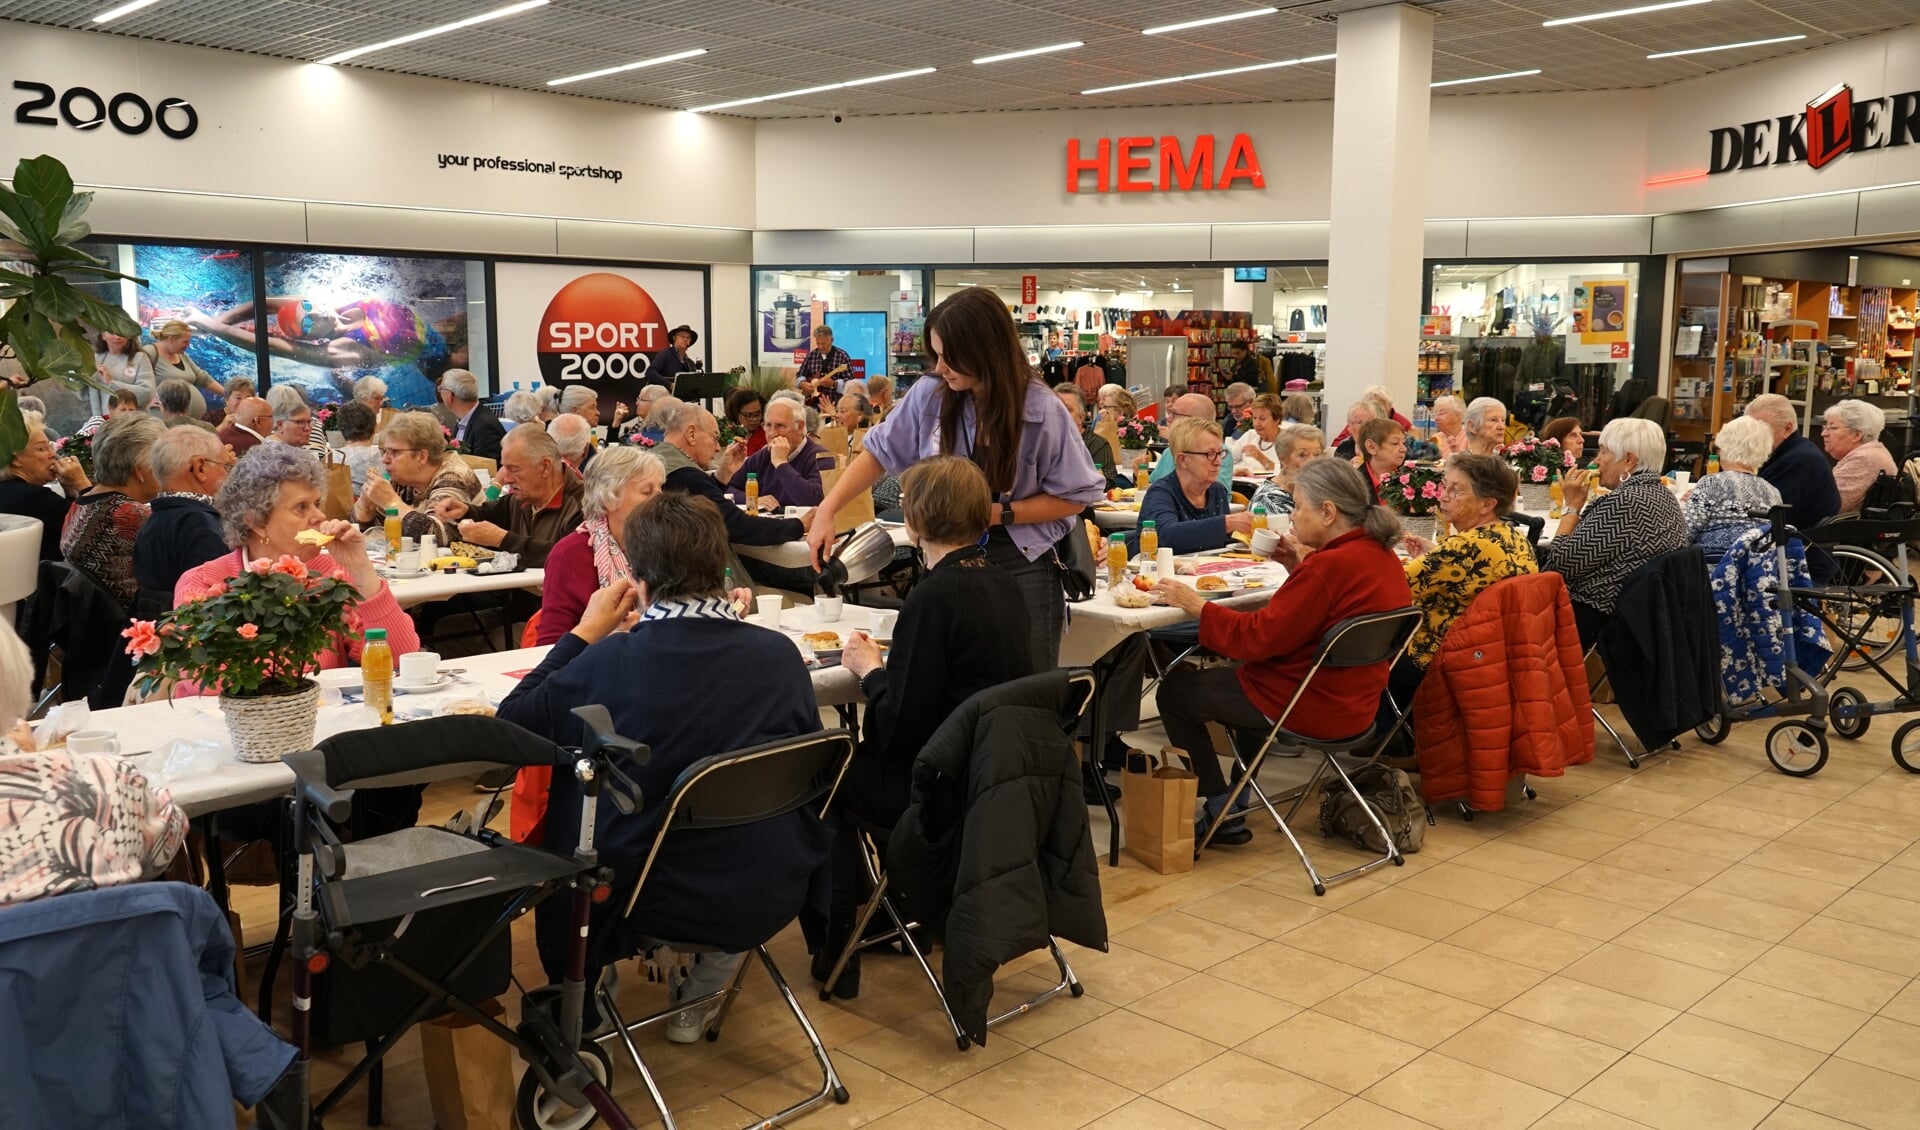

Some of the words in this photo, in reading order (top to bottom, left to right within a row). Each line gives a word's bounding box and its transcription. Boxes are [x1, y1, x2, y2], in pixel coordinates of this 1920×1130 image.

[13, 80, 198, 140] 2000
[438, 154, 469, 169] your
[473, 156, 555, 174] professional
[559, 165, 622, 183] sportshop
[1066, 133, 1266, 192] HEMA
[549, 322, 658, 348] SPORT
[560, 353, 650, 380] 2000
